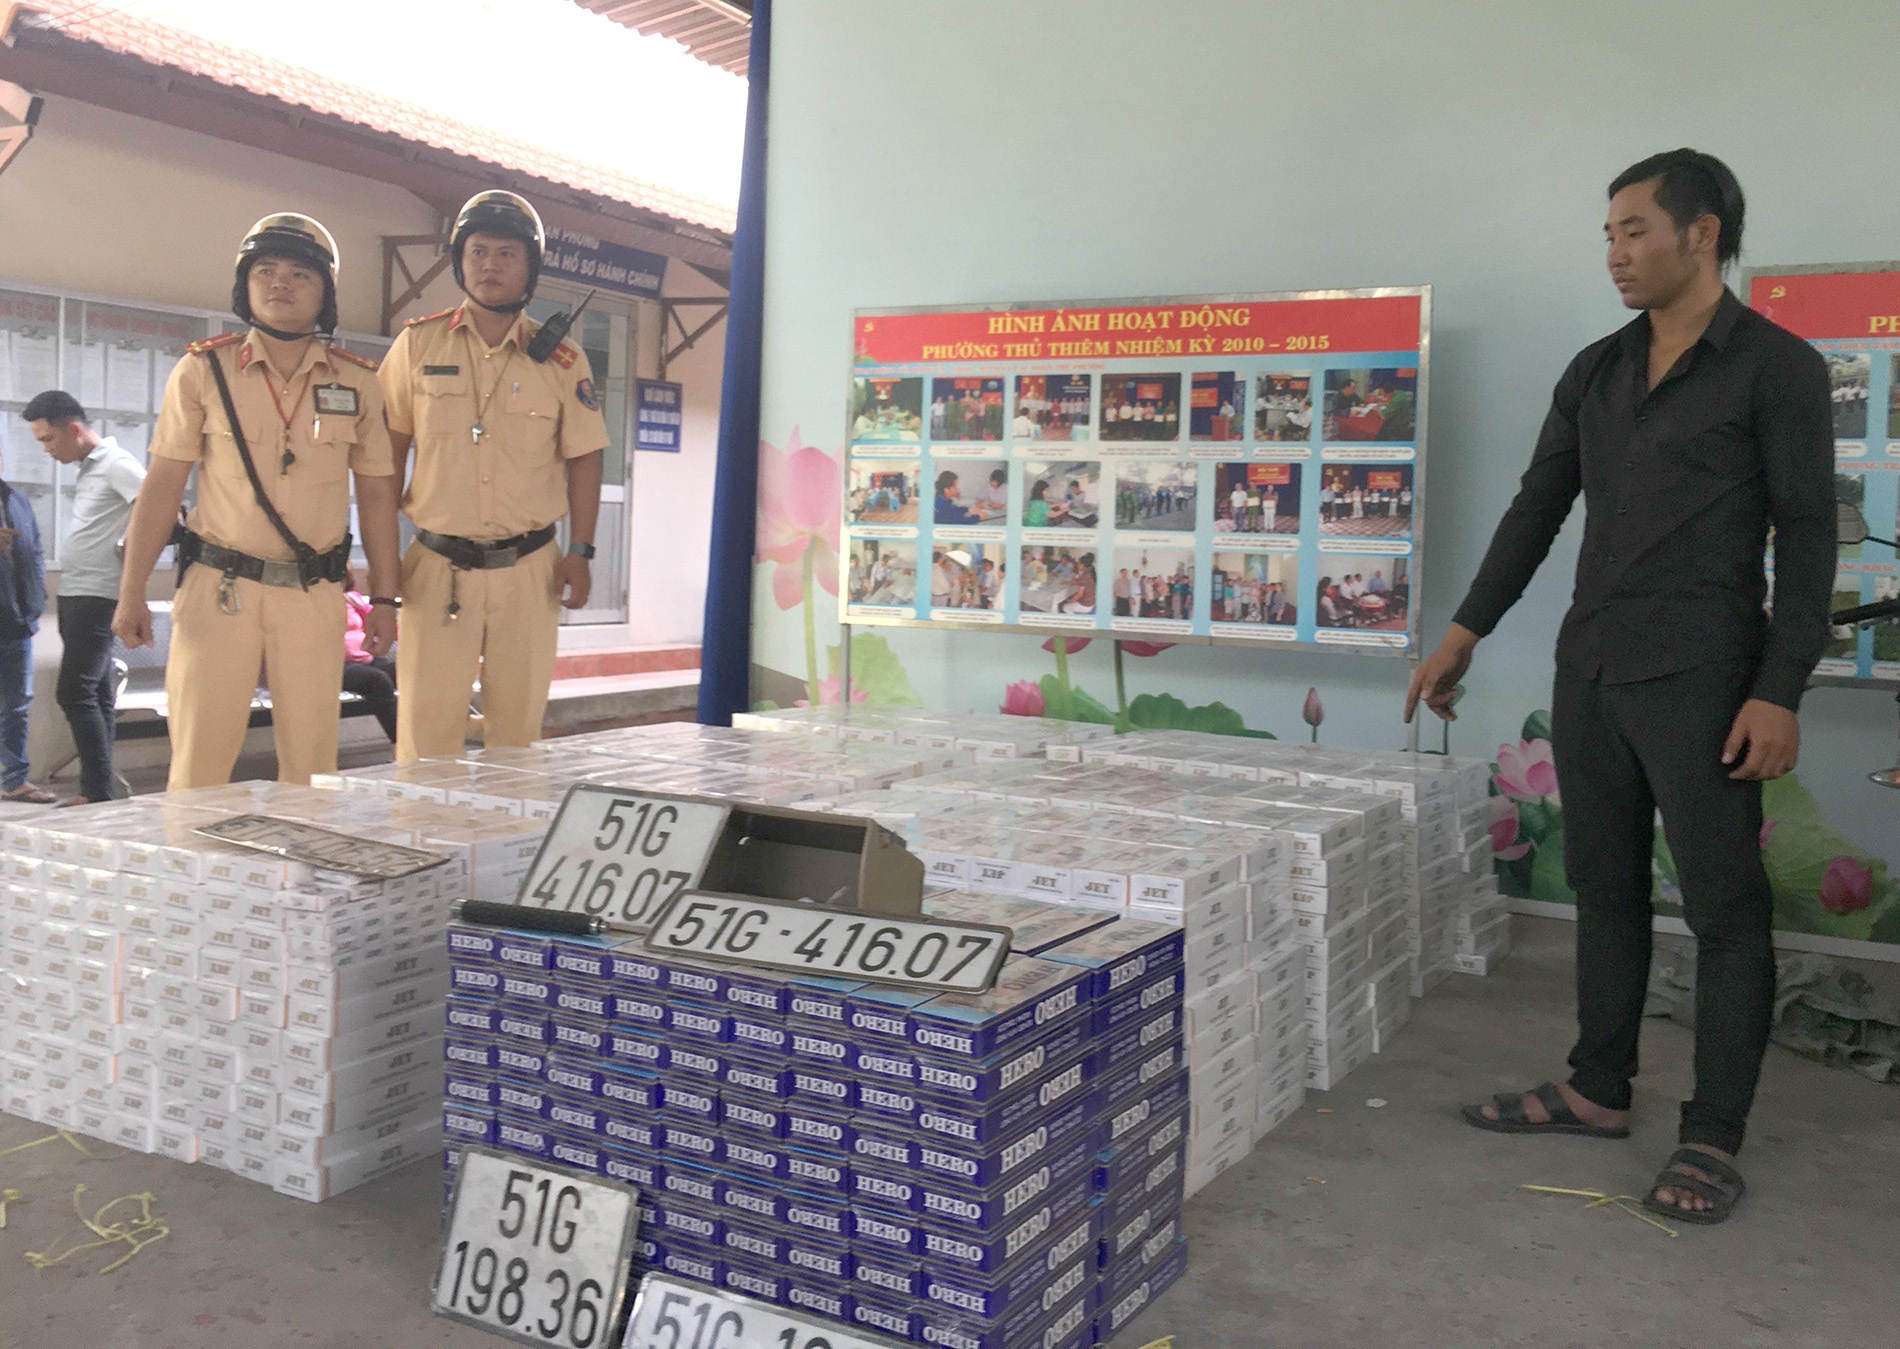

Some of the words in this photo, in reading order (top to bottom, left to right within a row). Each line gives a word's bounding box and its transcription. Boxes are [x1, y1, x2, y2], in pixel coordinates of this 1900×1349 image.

[988, 312, 1045, 334] HÌNH
[1050, 309, 1101, 332] ẢNH
[1107, 312, 1174, 333] HOẠT
[1179, 305, 1251, 331] ĐỘNG
[922, 341, 999, 359] PHƯỜNG
[1004, 338, 1042, 358] THỦ
[1047, 338, 1110, 357] THIÊM
[1115, 336, 1182, 357] NHIỆM
[1188, 334, 1215, 353] KỲ
[1222, 337, 1265, 352] 2010
[1286, 335, 1330, 351] 2015
[594, 799, 678, 858] 51G
[932, 862, 956, 873] JET
[982, 868, 1005, 879] JET
[532, 855, 691, 926] 416.07
[1032, 876, 1057, 888] JET
[1085, 882, 1110, 894] JET
[1142, 887, 1168, 899] JET
[450, 934, 493, 951] HERO
[501, 948, 544, 966] HERO
[557, 955, 602, 975] HERO
[455, 970, 498, 986] HERO
[613, 960, 659, 980] HERO
[669, 970, 718, 992] HERO
[503, 979, 548, 998] HERO
[727, 987, 778, 1009] HERO
[558, 994, 603, 1014] HERO
[616, 999, 663, 1019] HERO
[792, 998, 843, 1020] HERO
[1034, 985, 1078, 1025] HERO
[449, 1011, 491, 1029] HERO
[501, 1020, 543, 1039] HERO
[672, 1011, 720, 1033] HERO
[852, 1013, 906, 1035] HERO
[556, 1025, 600, 1047] HERO
[735, 1022, 784, 1044] HERO
[916, 1029, 973, 1053] HERO
[447, 1046, 488, 1064] HERO
[612, 1038, 659, 1058] HERO
[793, 1036, 846, 1058] HERO
[498, 1049, 541, 1070] HERO
[671, 1050, 718, 1072] HERO
[858, 1055, 913, 1078] HERO
[999, 1045, 1045, 1090] HERO
[547, 1069, 593, 1091] HERO
[727, 1069, 778, 1093] HERO
[795, 1074, 847, 1097] HERO
[920, 1066, 977, 1091] HERO
[1039, 1064, 1082, 1106] HERO
[448, 1082, 490, 1101] HERO
[500, 1088, 542, 1109] HERO
[602, 1082, 649, 1105] HERO
[664, 1088, 712, 1112] HERO
[860, 1087, 914, 1111] HERO
[446, 1114, 487, 1134] HERO
[550, 1107, 596, 1129] HERO
[725, 1103, 776, 1127] HERO
[920, 1113, 977, 1140] HERO
[500, 1125, 543, 1148] HERO
[605, 1121, 652, 1145] HERO
[666, 1129, 714, 1152] HERO
[790, 1118, 842, 1140] HERO
[552, 1145, 598, 1167] HERO
[727, 1143, 776, 1168] HERO
[855, 1138, 909, 1162] HERO
[1000, 1126, 1047, 1174] HERO
[606, 1161, 653, 1184] HERO
[789, 1159, 840, 1182] HERO
[920, 1149, 978, 1175] HERO
[665, 1175, 714, 1200] HERO
[856, 1175, 911, 1200] HERO
[1003, 1166, 1050, 1216] HERO
[499, 1169, 582, 1254] 51G
[725, 1190, 776, 1216] HERO
[924, 1192, 981, 1219] HERO
[664, 1211, 714, 1235] HERO
[788, 1208, 840, 1232] HERO
[855, 1217, 911, 1243] HERO
[1005, 1207, 1051, 1258] HERO
[726, 1232, 777, 1258] HERO
[926, 1234, 983, 1261] HERO
[1047, 1221, 1090, 1270] HERO
[665, 1255, 714, 1280] HERO
[789, 1249, 841, 1274] HERO
[727, 1271, 777, 1298] HERO
[856, 1266, 911, 1293] HERO
[1042, 1260, 1085, 1311] HERO
[450, 1240, 604, 1348] 198.36
[789, 1288, 841, 1316] HERO
[928, 1284, 986, 1313] HERO
[855, 1307, 909, 1334] HERO
[1044, 1300, 1084, 1349] HERO
[923, 1326, 980, 1349] HERO
